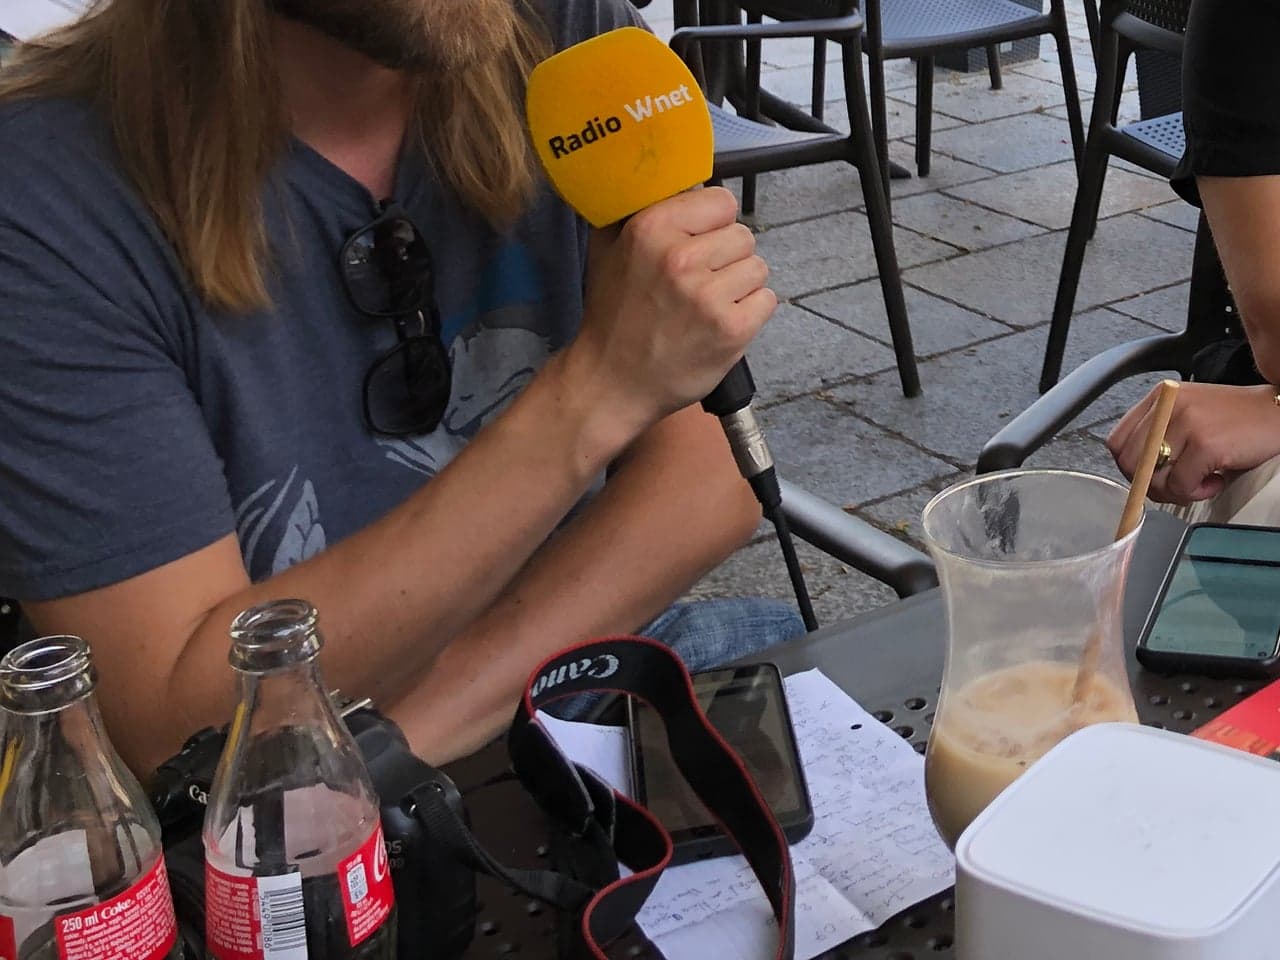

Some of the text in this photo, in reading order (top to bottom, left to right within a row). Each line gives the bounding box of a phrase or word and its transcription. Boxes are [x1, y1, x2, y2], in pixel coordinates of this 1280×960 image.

[549, 84, 692, 159] Radio Wnet
[531, 654, 620, 698] Cano
[62, 898, 132, 933] 250 ml Coke
